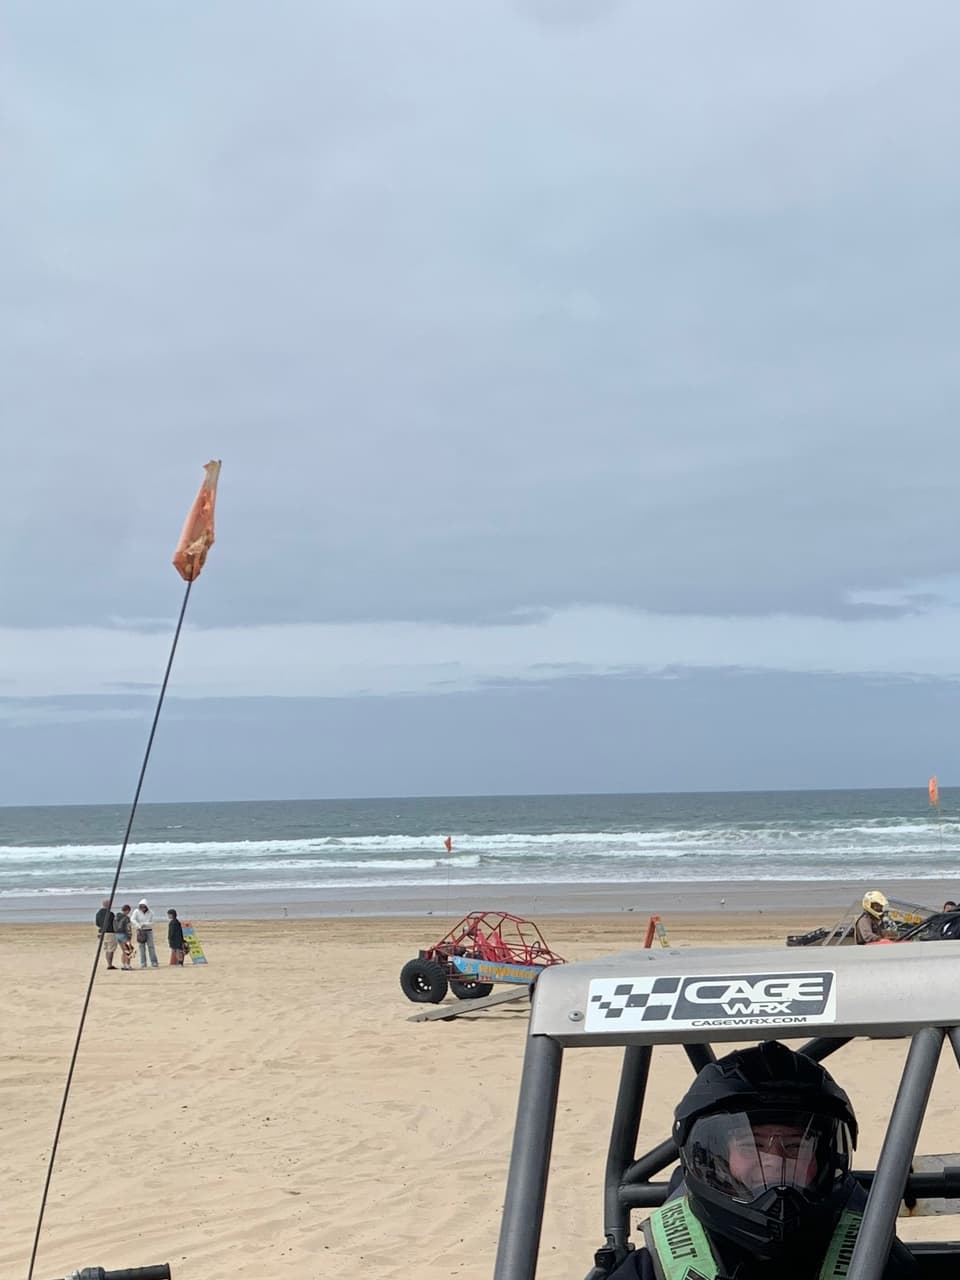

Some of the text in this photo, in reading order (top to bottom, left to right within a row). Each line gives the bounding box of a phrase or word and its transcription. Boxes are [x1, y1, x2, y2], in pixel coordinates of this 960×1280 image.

[685, 977, 824, 1004] CAGE
[721, 1001, 793, 1015] WRX
[691, 1016, 807, 1027] CAGEWRX.COM
[660, 1204, 698, 1260] ASSAULT
